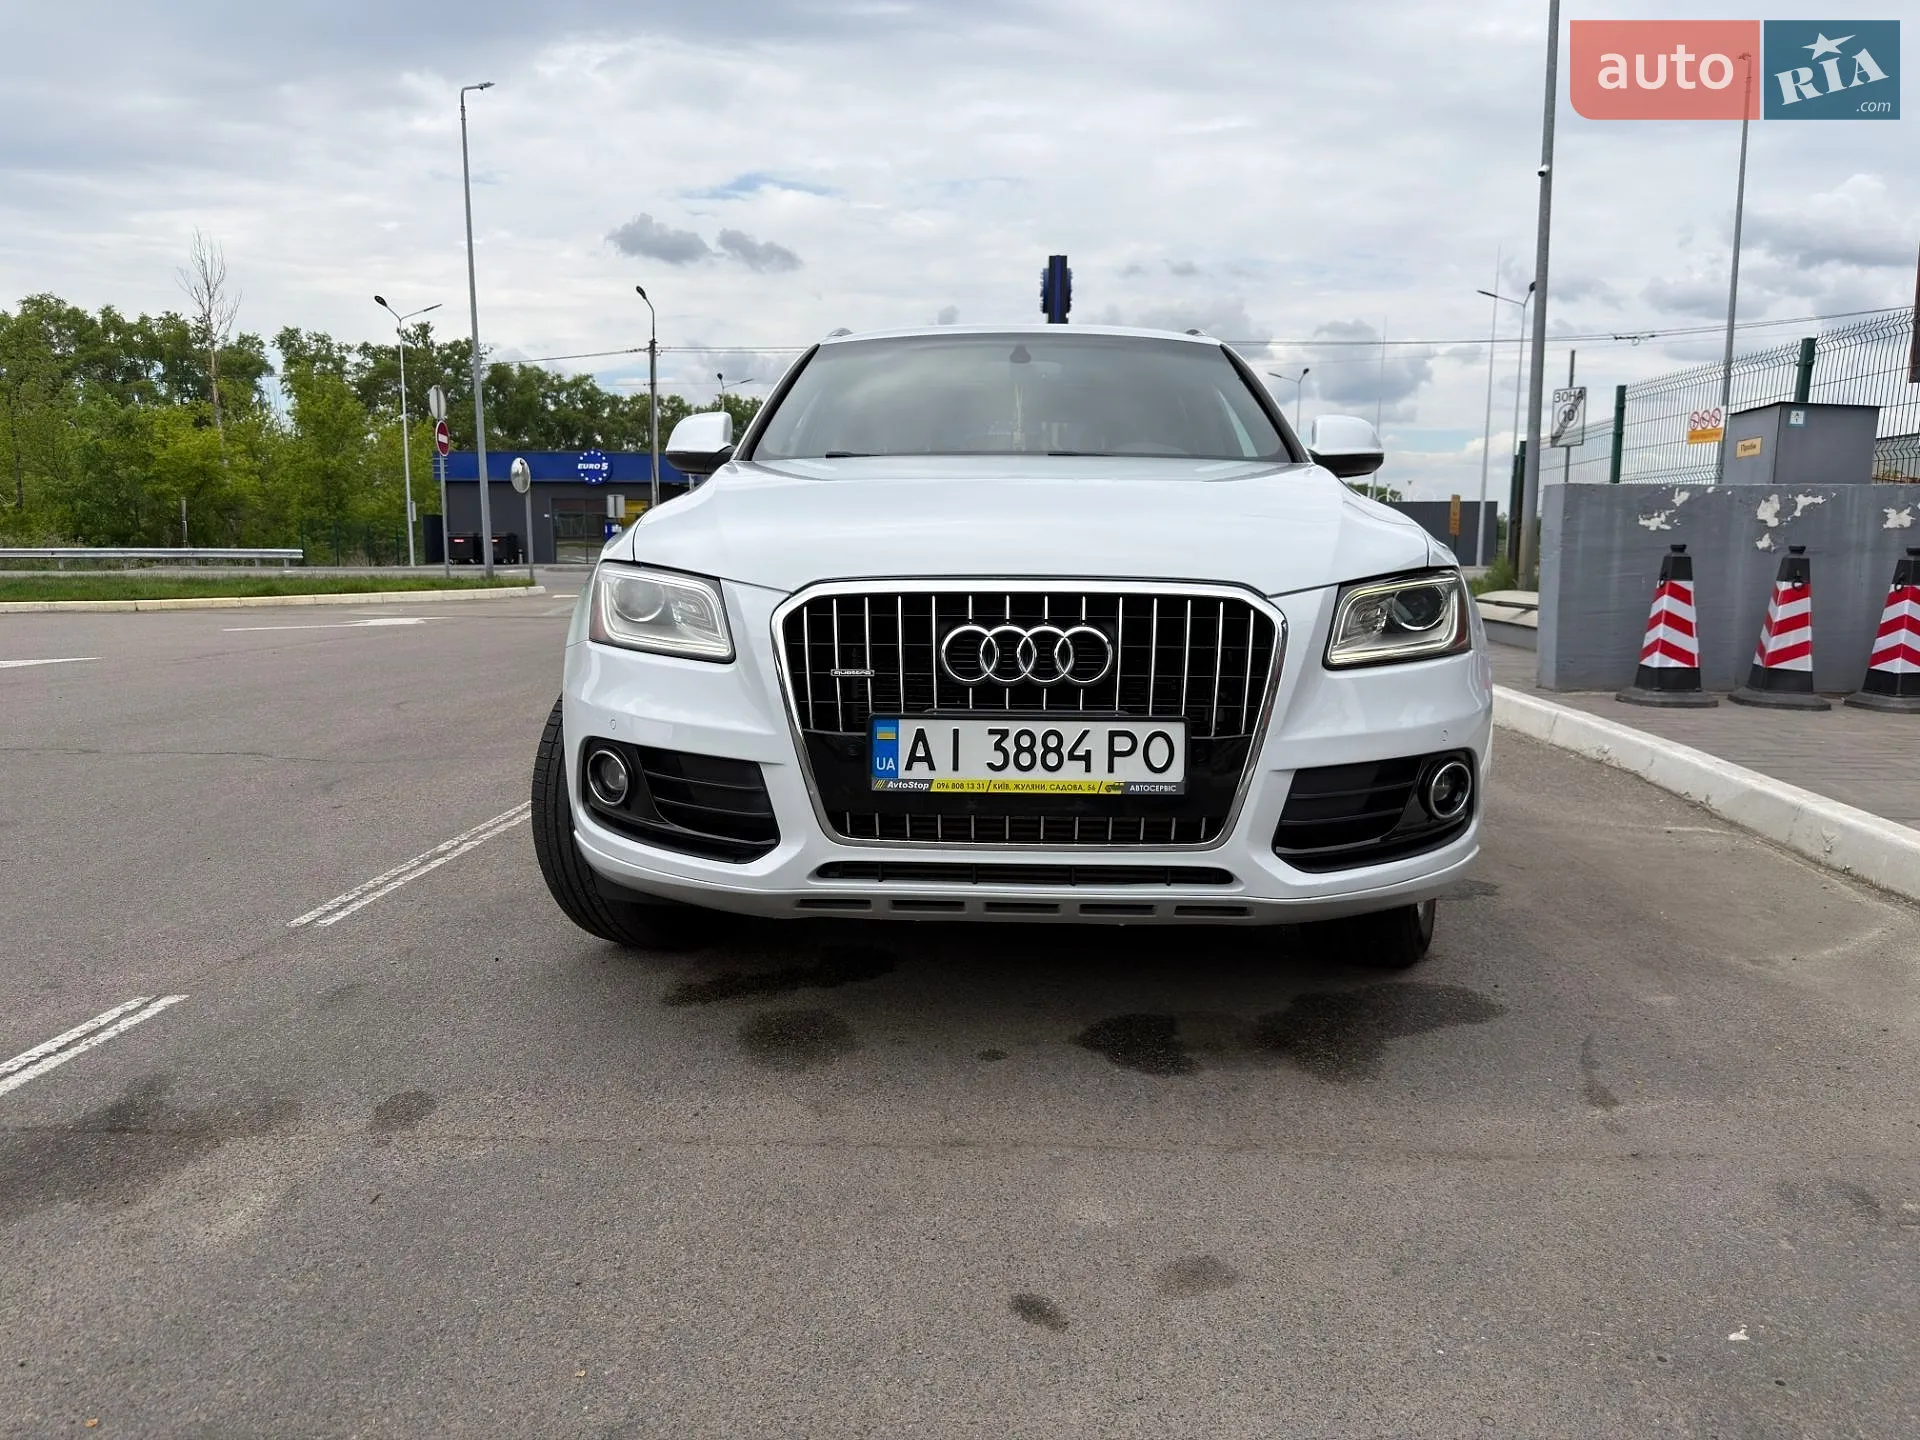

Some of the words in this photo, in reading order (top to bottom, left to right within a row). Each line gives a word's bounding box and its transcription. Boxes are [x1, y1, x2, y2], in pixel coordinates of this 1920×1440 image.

[1553, 389, 1584, 403] ЗОНА
[904, 727, 960, 772] AI
[985, 727, 1091, 773] 3884
[1107, 729, 1175, 774] PO
[876, 757, 896, 771] UA
[887, 780, 930, 791] AvtoStop
[1129, 784, 1177, 792] АВТОСЕРВІС
